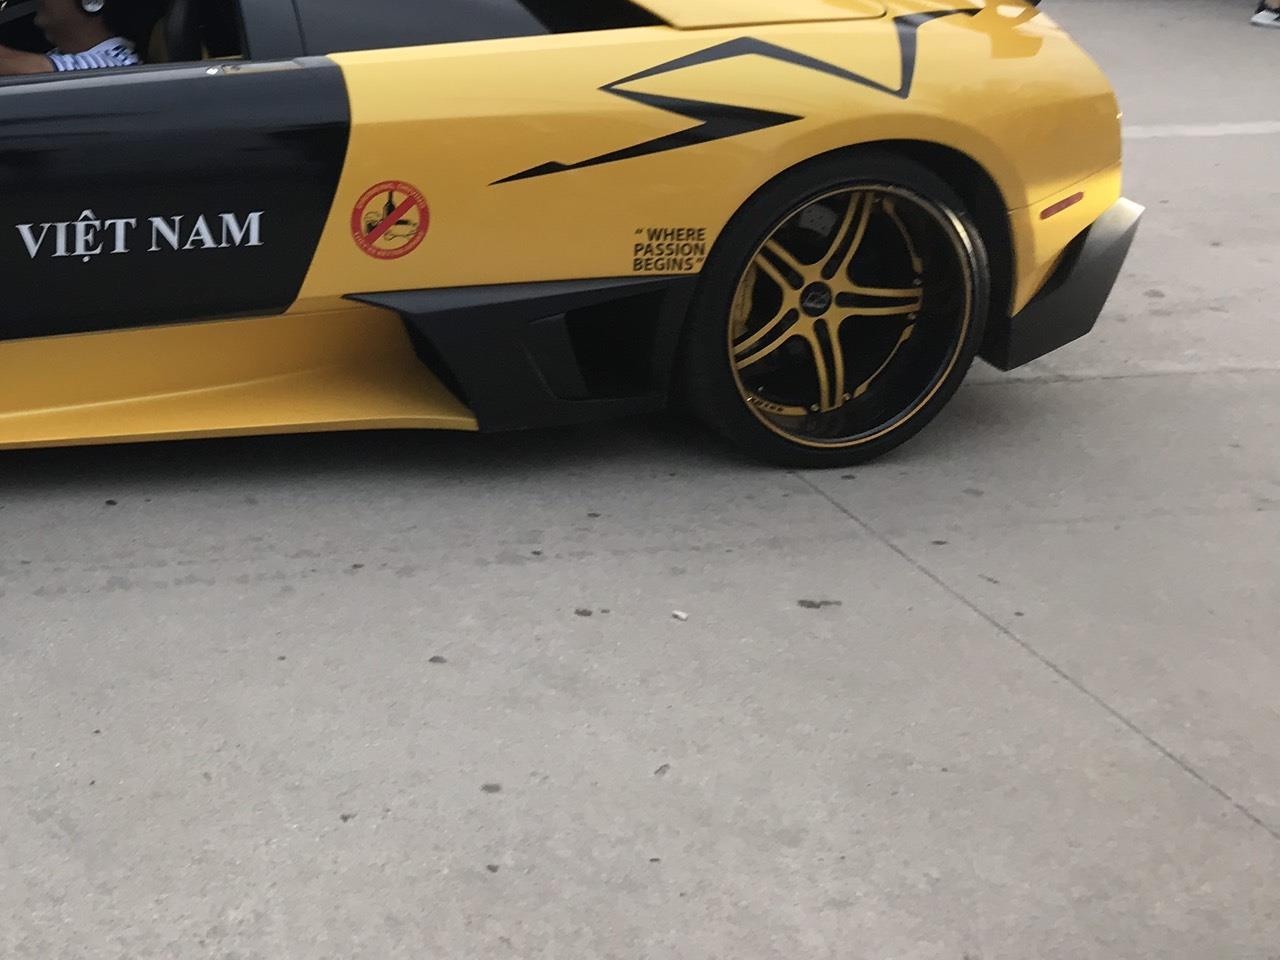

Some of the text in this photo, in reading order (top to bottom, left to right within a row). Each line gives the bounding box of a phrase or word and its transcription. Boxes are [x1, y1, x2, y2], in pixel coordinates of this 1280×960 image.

[15, 208, 137, 263] VIỆT
[146, 211, 265, 252] NAM
[634, 242, 705, 257] PASSION
